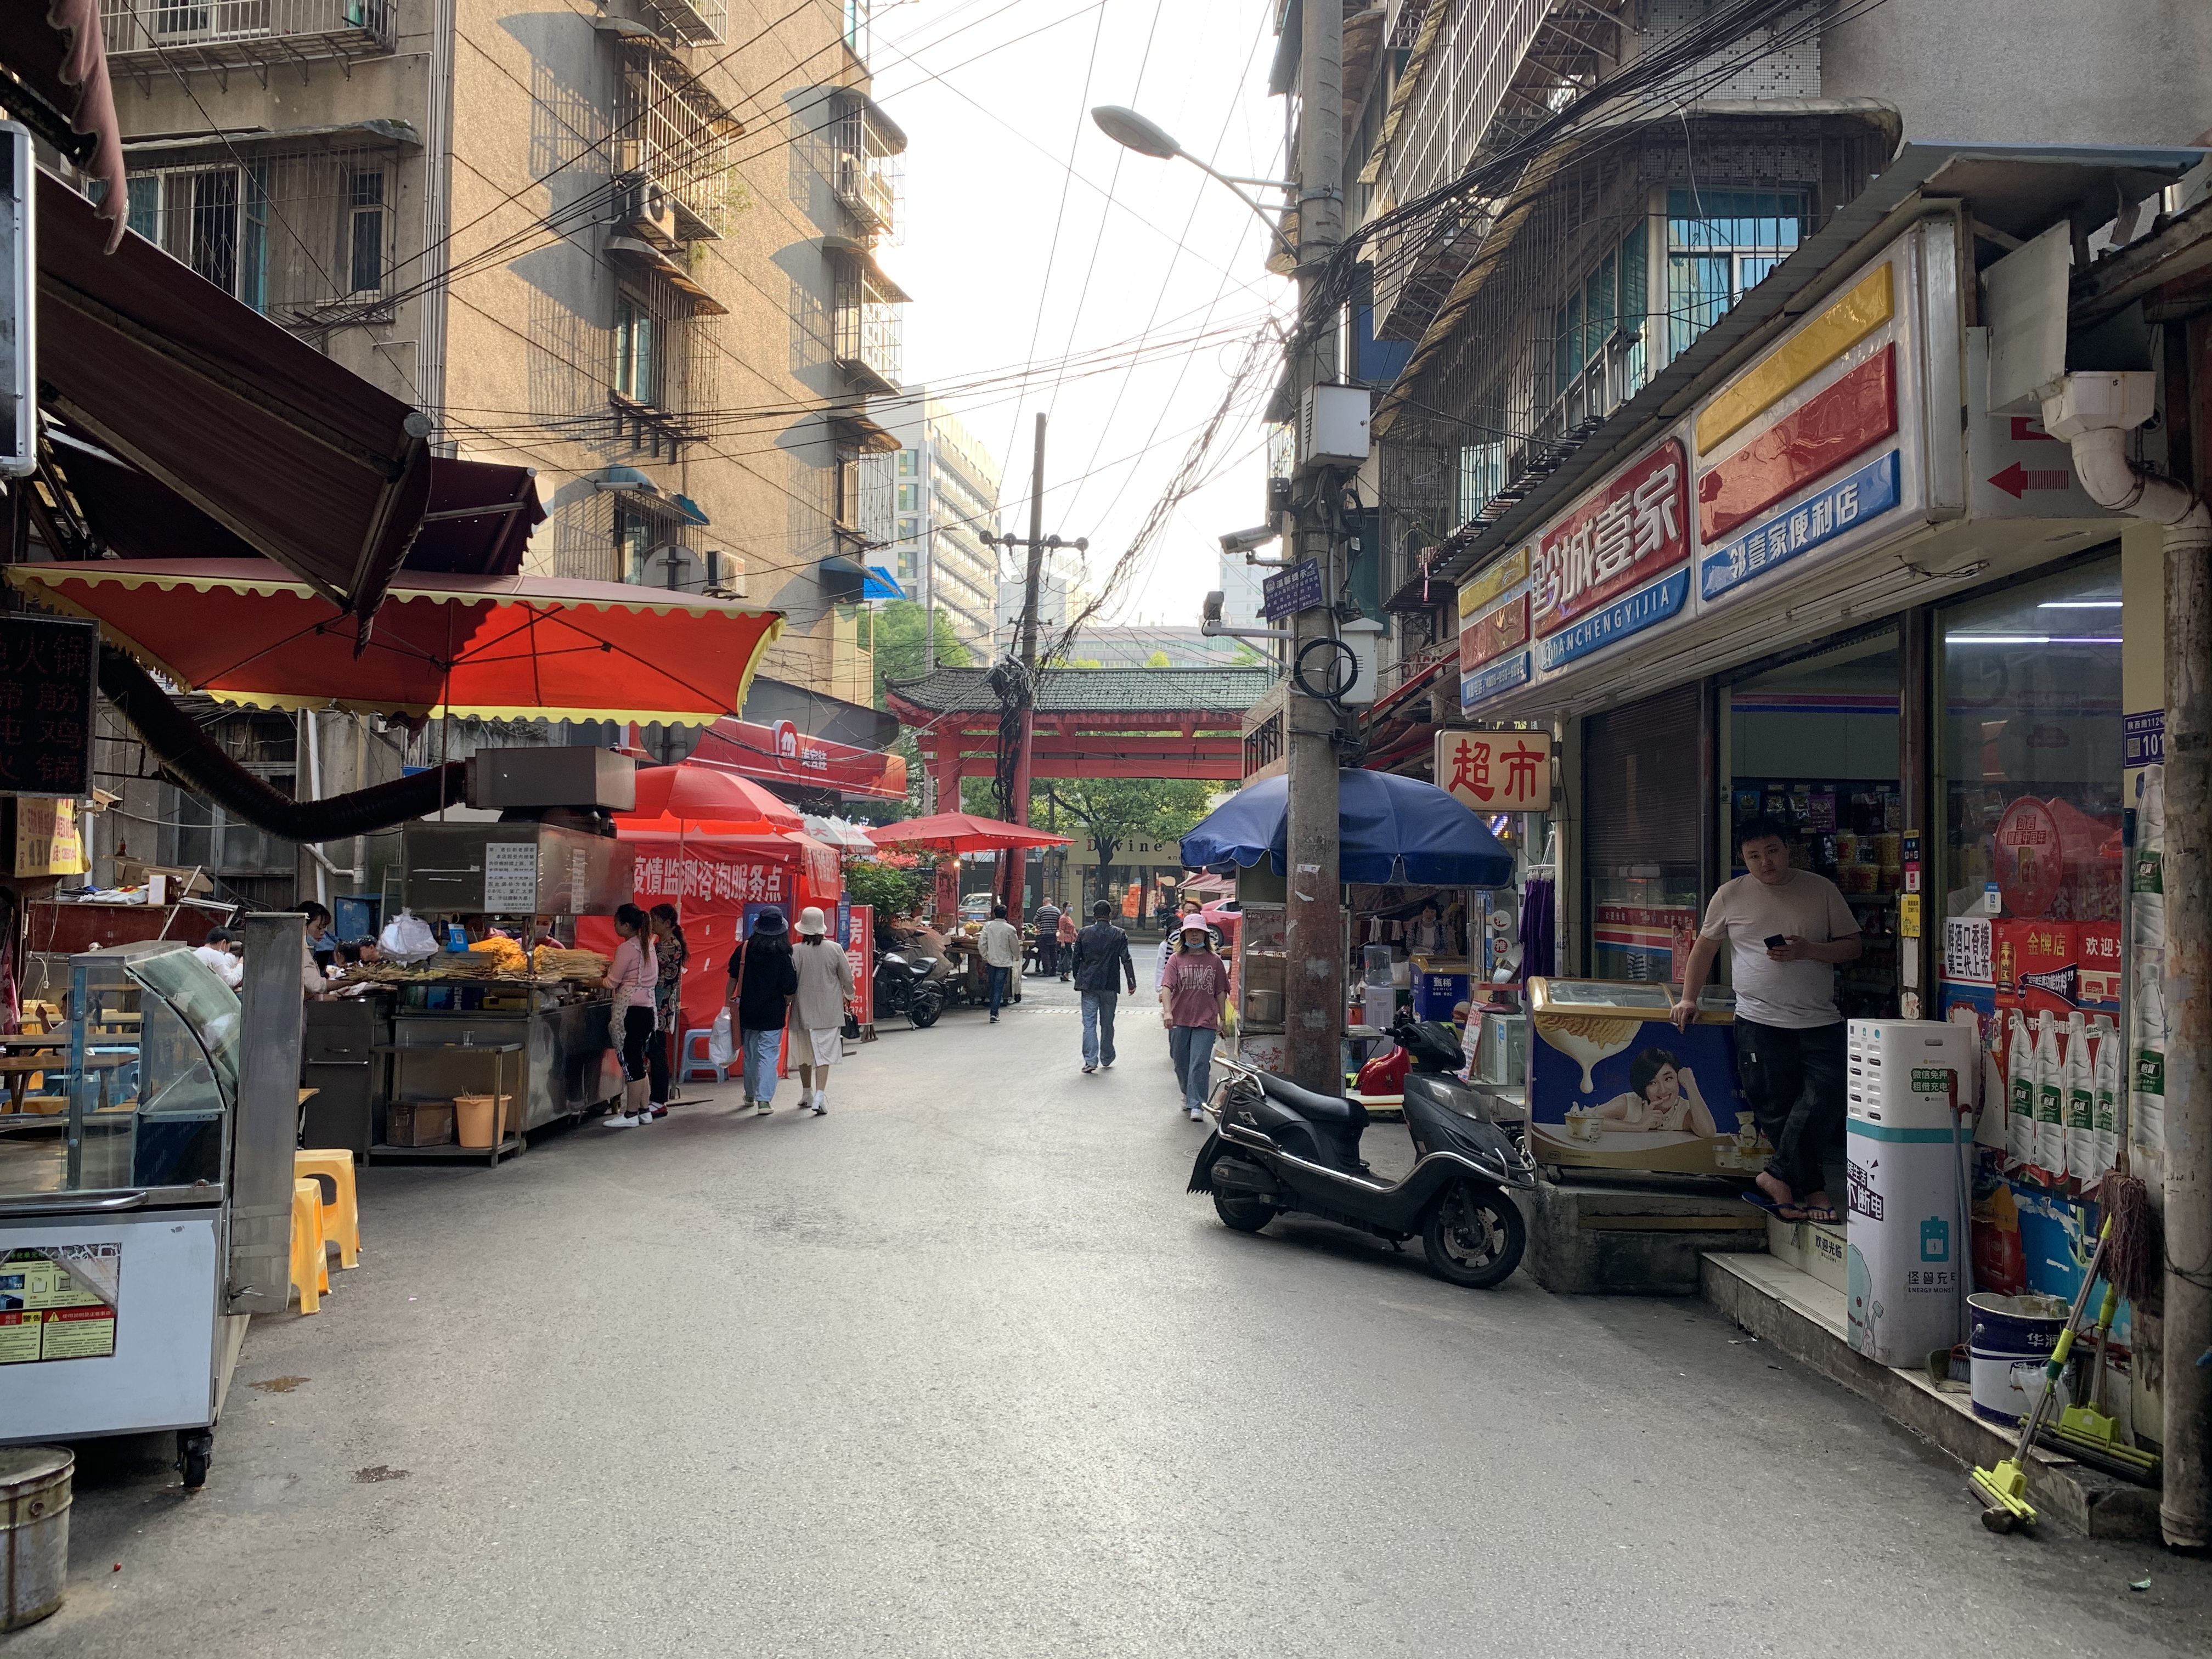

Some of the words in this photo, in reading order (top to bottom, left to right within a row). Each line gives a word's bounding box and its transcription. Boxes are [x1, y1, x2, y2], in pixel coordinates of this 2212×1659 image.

[1532, 463, 1680, 620] 黔城壹家
[1729, 483, 1859, 579] 邻壹家便利店
[1276, 569, 1307, 588] 温馨提示
[2143, 733, 2164, 757] 101
[1449, 738, 1545, 802] 超市
[1086, 838, 1163, 852] Dvine
[2007, 831, 2046, 845] 健康中国年
[634, 855, 783, 901] 疫情监测咨询服务点
[1495, 940, 1507, 952] 推
[1948, 922, 1989, 956] 解酒口香糖
[2027, 932, 2066, 957] 金牌店
[1948, 953, 1989, 978] 第三代上市
[1912, 1082, 1950, 1092] 租借充电
[1815, 1235, 1842, 1259] 欢迎光临
[2027, 1333, 2059, 1347] 华润
